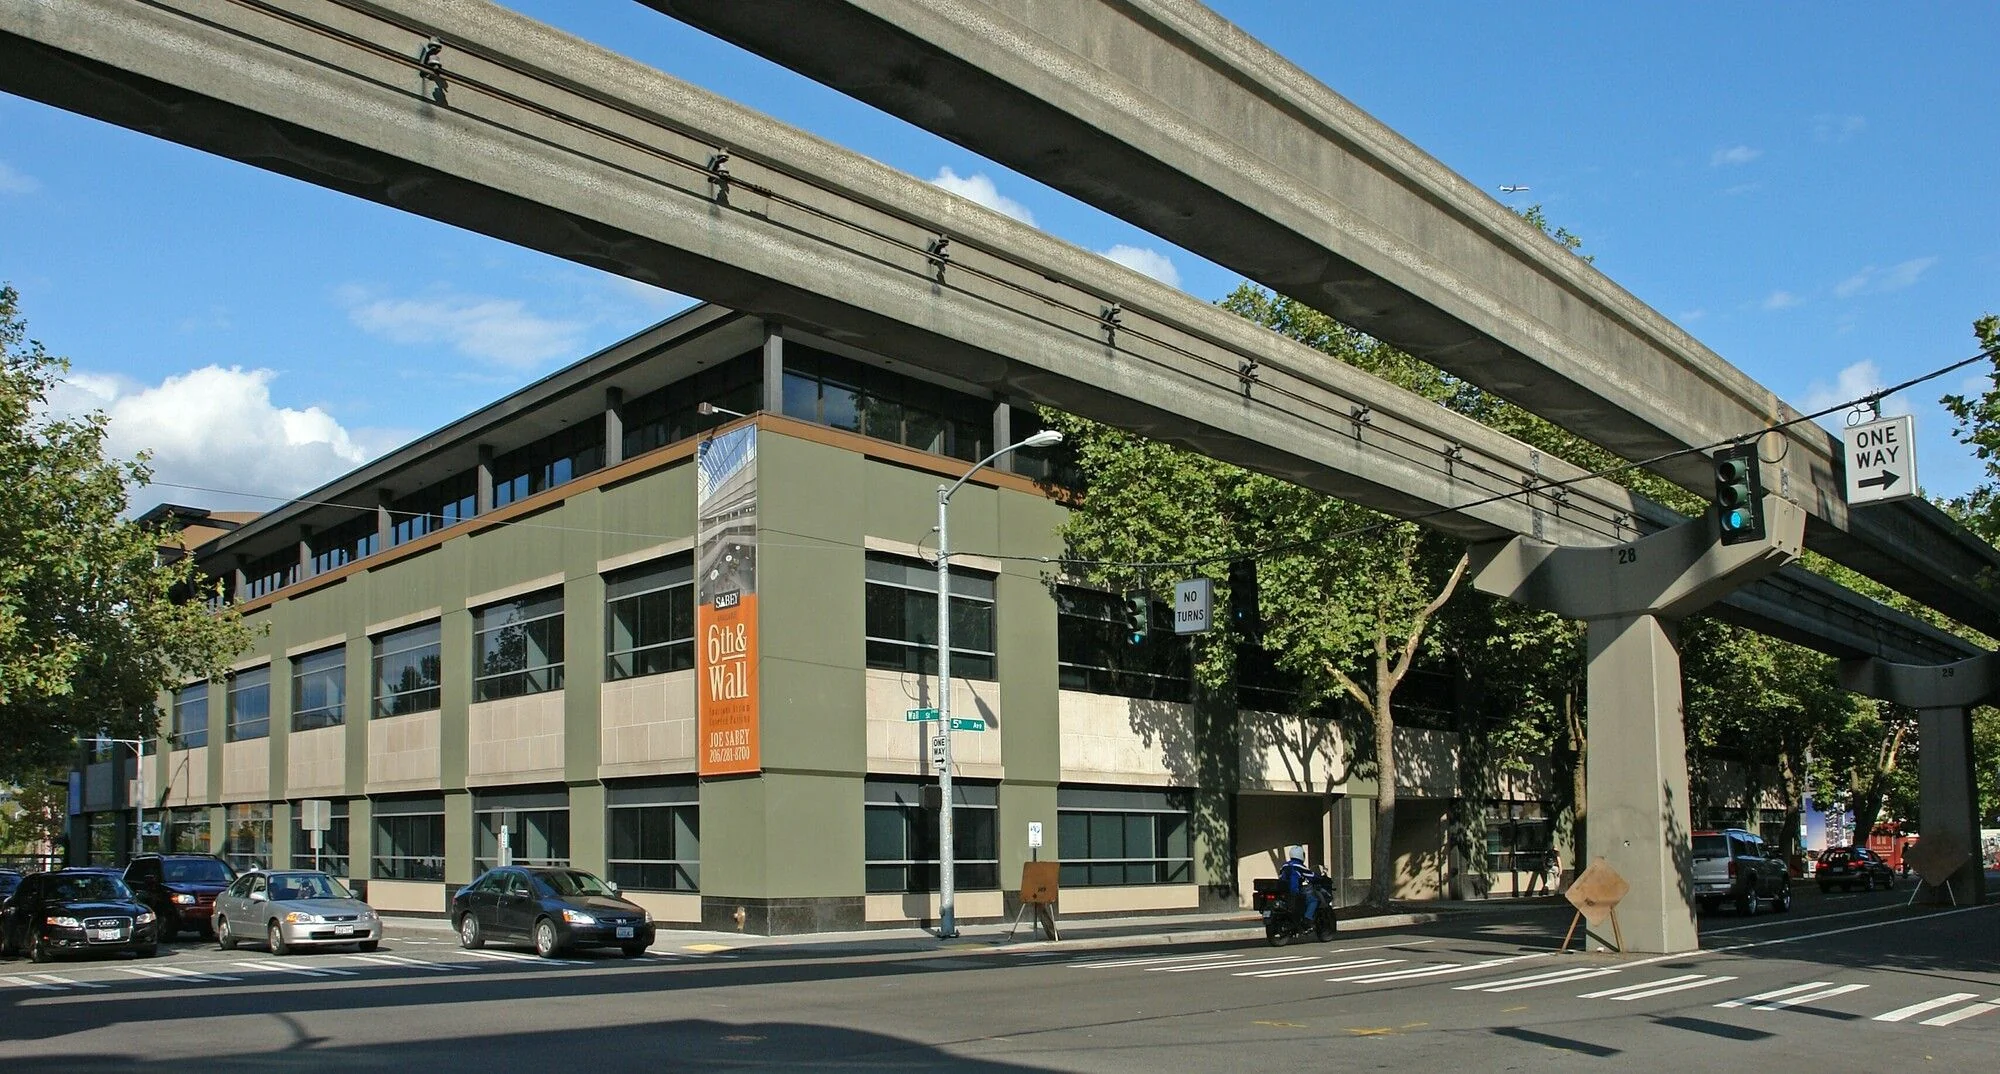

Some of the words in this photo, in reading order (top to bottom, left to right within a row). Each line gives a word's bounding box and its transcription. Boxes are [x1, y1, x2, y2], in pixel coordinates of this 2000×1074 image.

[1856, 426, 1897, 448] ONE
[1856, 446, 1899, 469] WAY
[715, 591, 739, 609] SABEY
[1184, 591, 1197, 602] NO
[1177, 609, 1204, 622] TURNS
[1942, 667, 1954, 678] 29
[708, 661, 749, 702] Wall
[908, 711, 919, 720] Wall
[710, 731, 723, 747] JOE
[725, 728, 750, 747] SABEY
[933, 738, 945, 747] ONE
[709, 746, 750, 763] 206/281-8700
